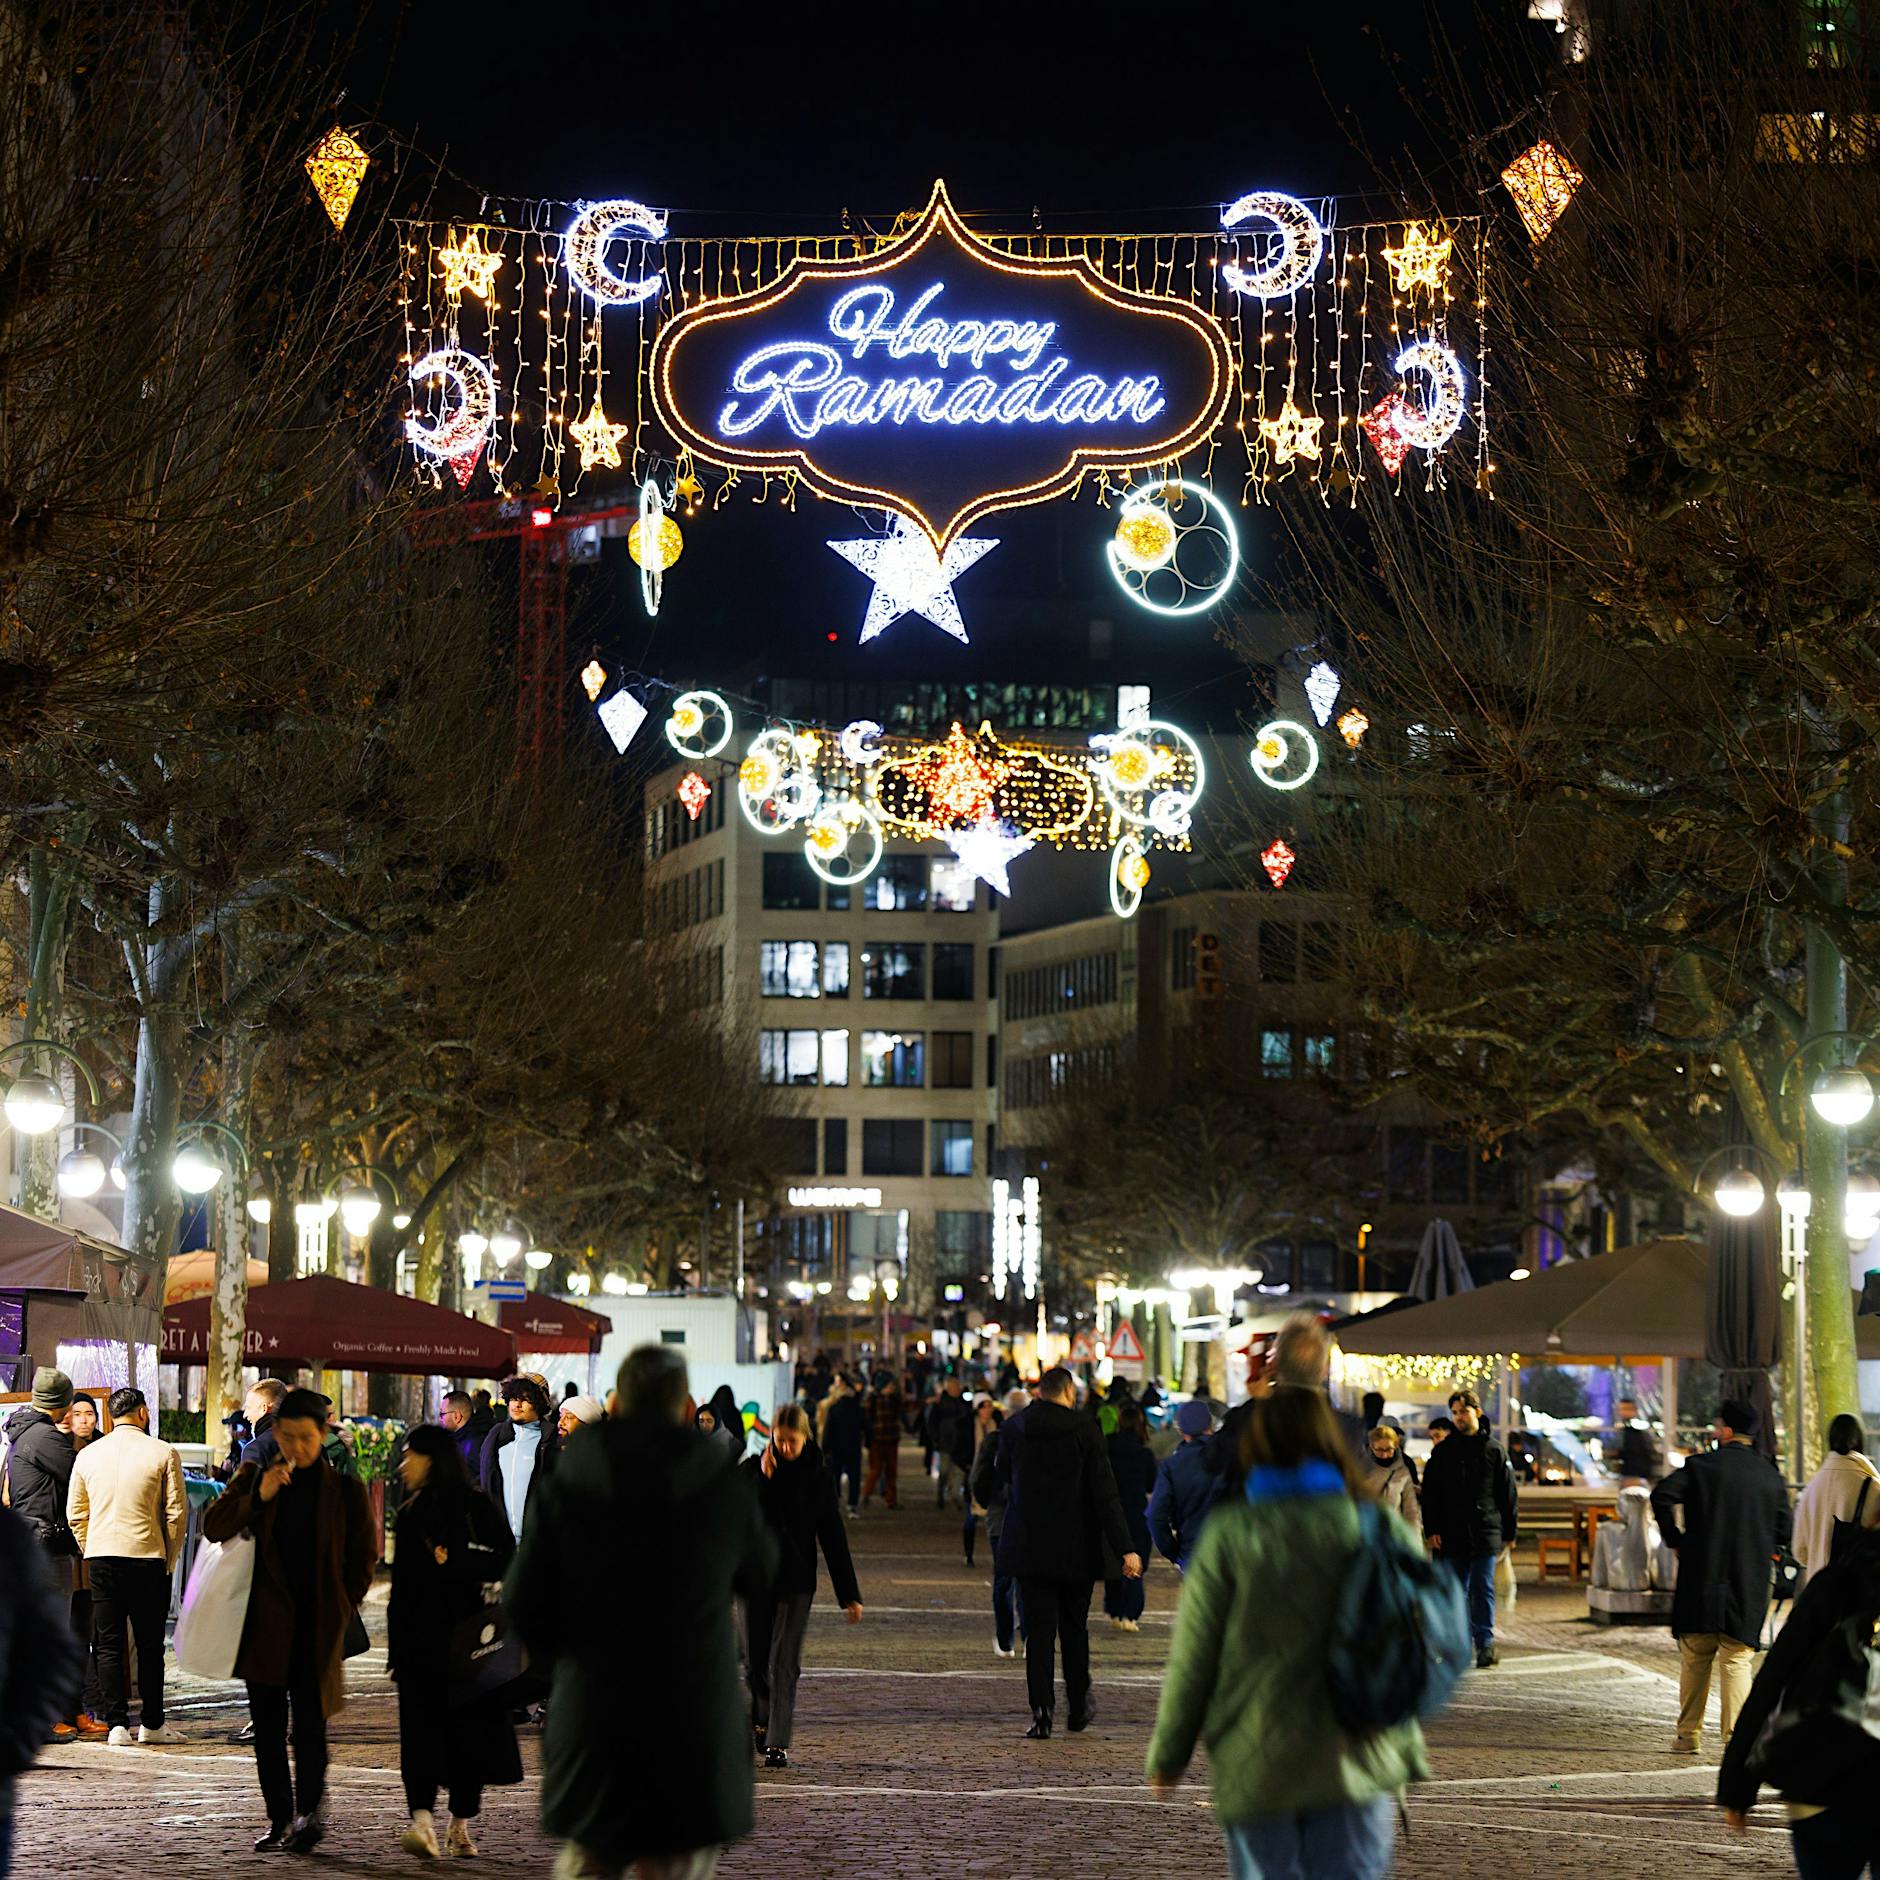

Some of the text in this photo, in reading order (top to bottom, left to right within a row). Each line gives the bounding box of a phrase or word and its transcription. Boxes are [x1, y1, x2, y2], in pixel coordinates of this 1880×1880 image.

[829, 282, 1056, 369] Happy
[718, 342, 1166, 439] Ramadan
[160, 1328, 186, 1352] RET
[333, 1341, 480, 1357] Organic Coffee Freshly Made Food
